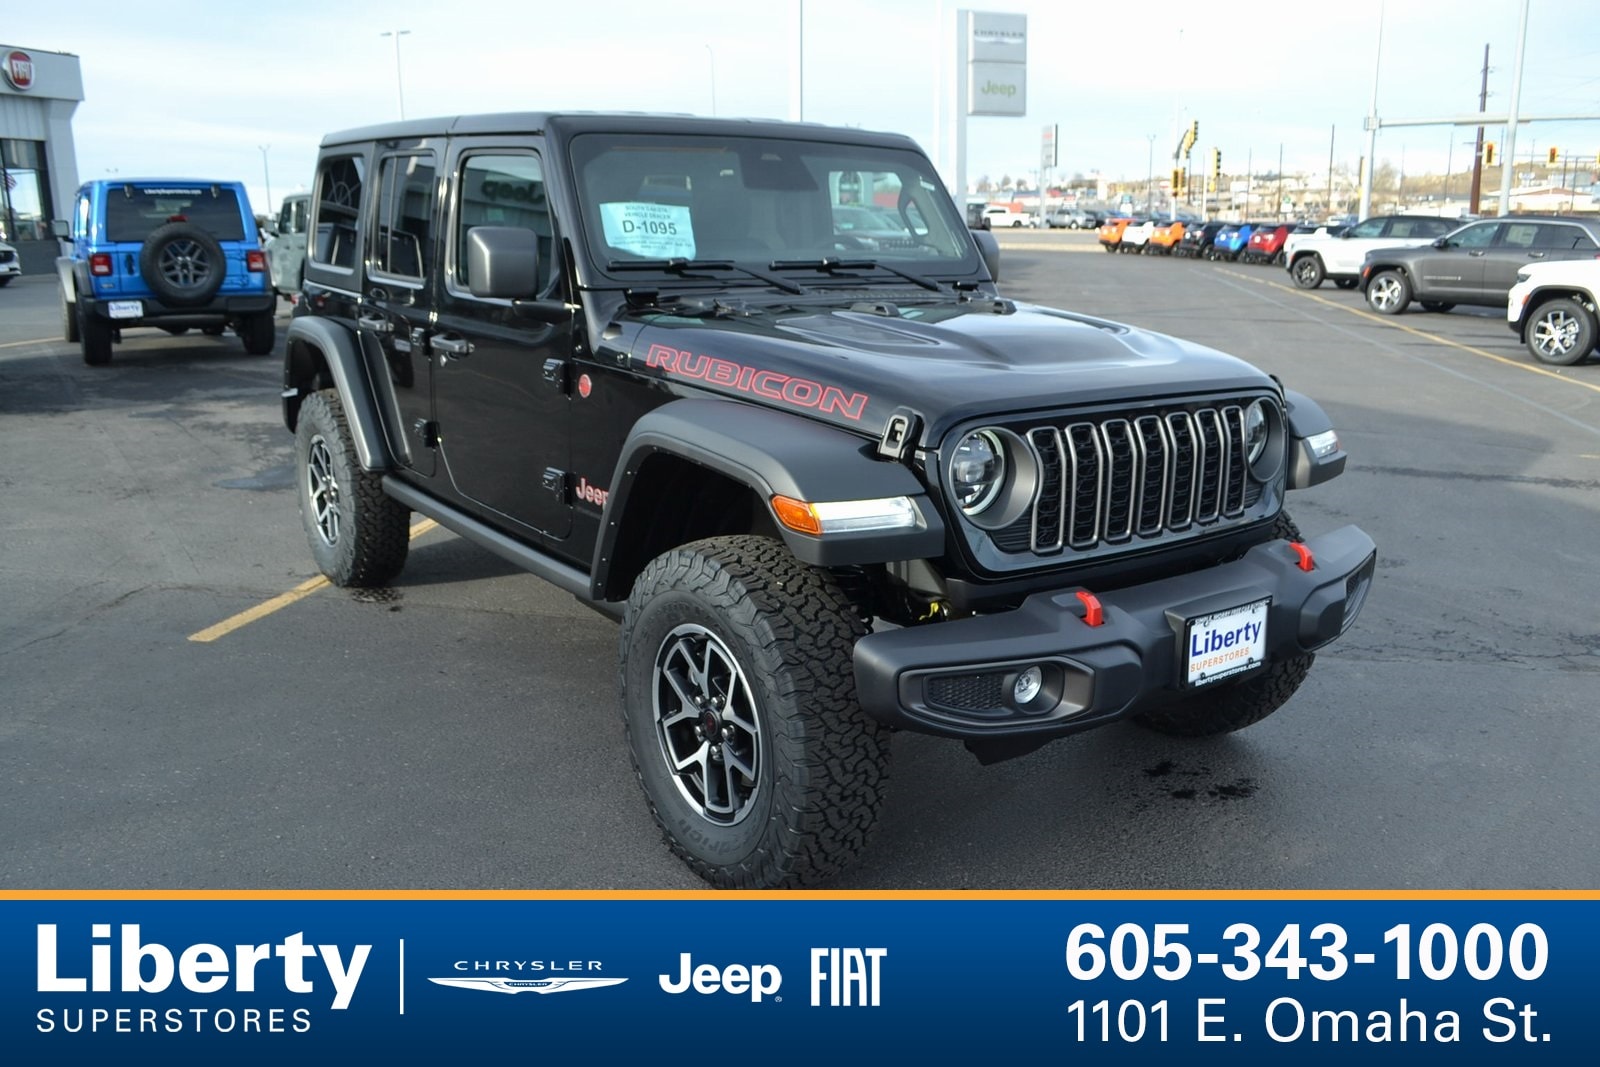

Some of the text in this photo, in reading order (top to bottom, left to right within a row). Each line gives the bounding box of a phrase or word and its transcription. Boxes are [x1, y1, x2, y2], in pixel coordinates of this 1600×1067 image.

[12, 59, 35, 80] FIAT
[980, 80, 1017, 98] Jeep
[622, 220, 677, 235] D-1095
[646, 344, 868, 420] RUBICON
[1192, 621, 1262, 657] Liberty
[1190, 647, 1250, 672] SUPERSTORES
